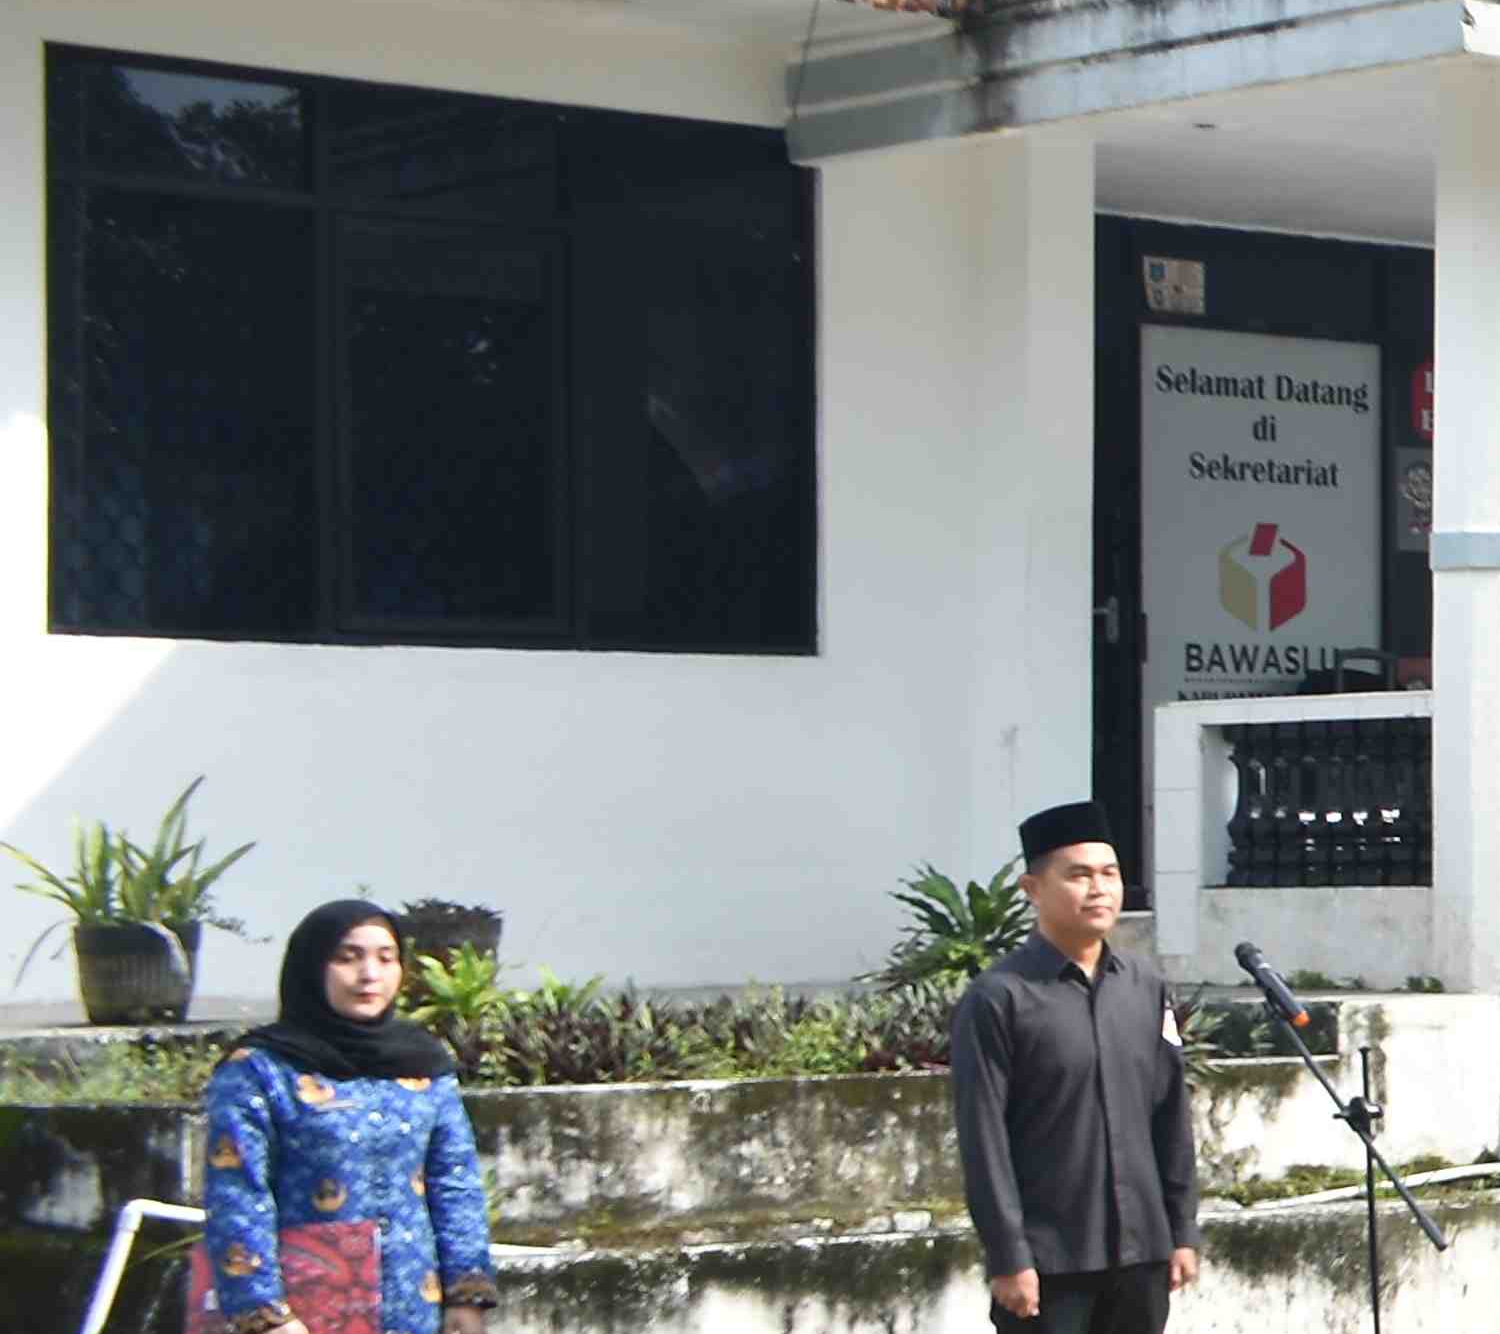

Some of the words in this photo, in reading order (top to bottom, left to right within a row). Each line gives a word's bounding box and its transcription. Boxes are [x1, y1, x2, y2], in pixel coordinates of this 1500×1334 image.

[1155, 364, 1265, 401] Selamat
[1275, 373, 1370, 414] Datang
[1252, 415, 1278, 443] di
[1188, 451, 1339, 489] Sekretariat
[1184, 642, 1339, 675] BAWASLU
